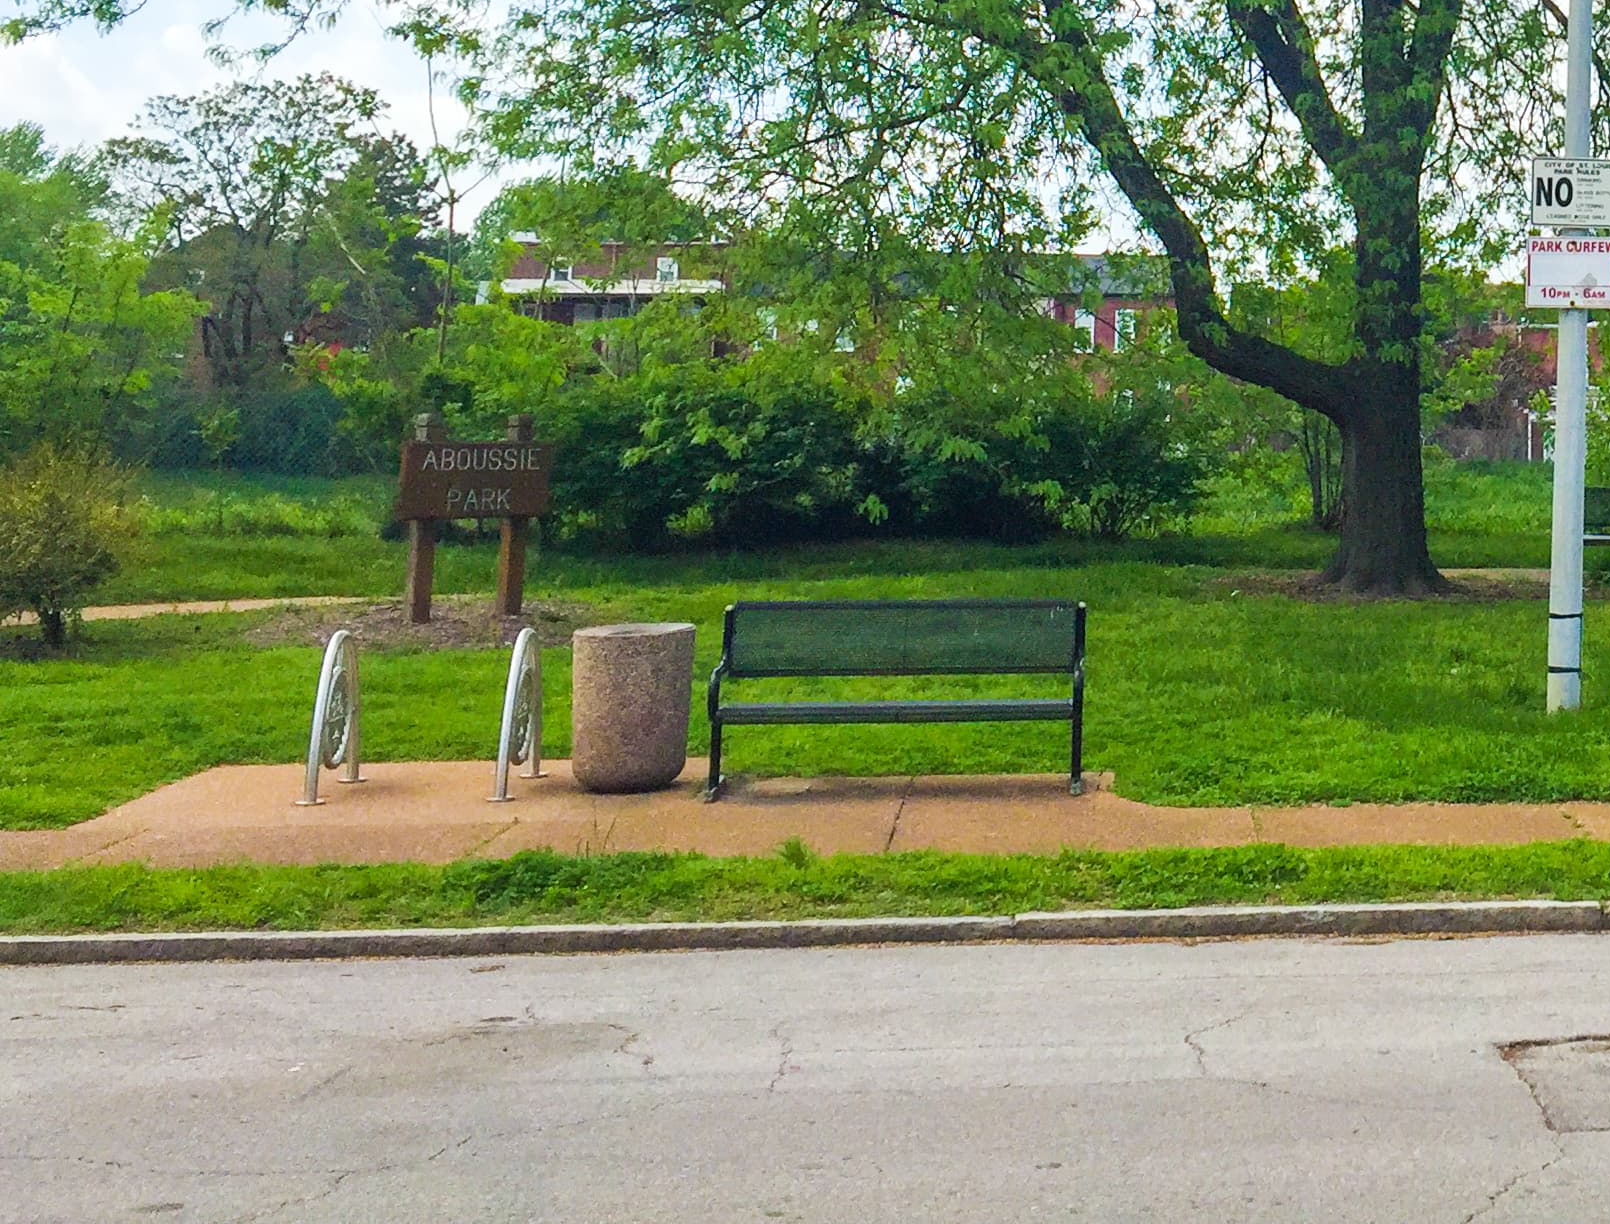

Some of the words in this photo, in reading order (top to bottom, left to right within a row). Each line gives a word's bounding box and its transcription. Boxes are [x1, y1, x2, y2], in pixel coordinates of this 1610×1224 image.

[1544, 161, 1562, 169] CITY
[1565, 161, 1575, 169] OF
[1535, 177, 1574, 208] NO
[1531, 240, 1563, 253] PARK
[1540, 287, 1571, 299] 10PM
[1582, 287, 1606, 299] 6AM
[422, 447, 543, 471] ABOUSSIE
[446, 487, 512, 512] PARK
